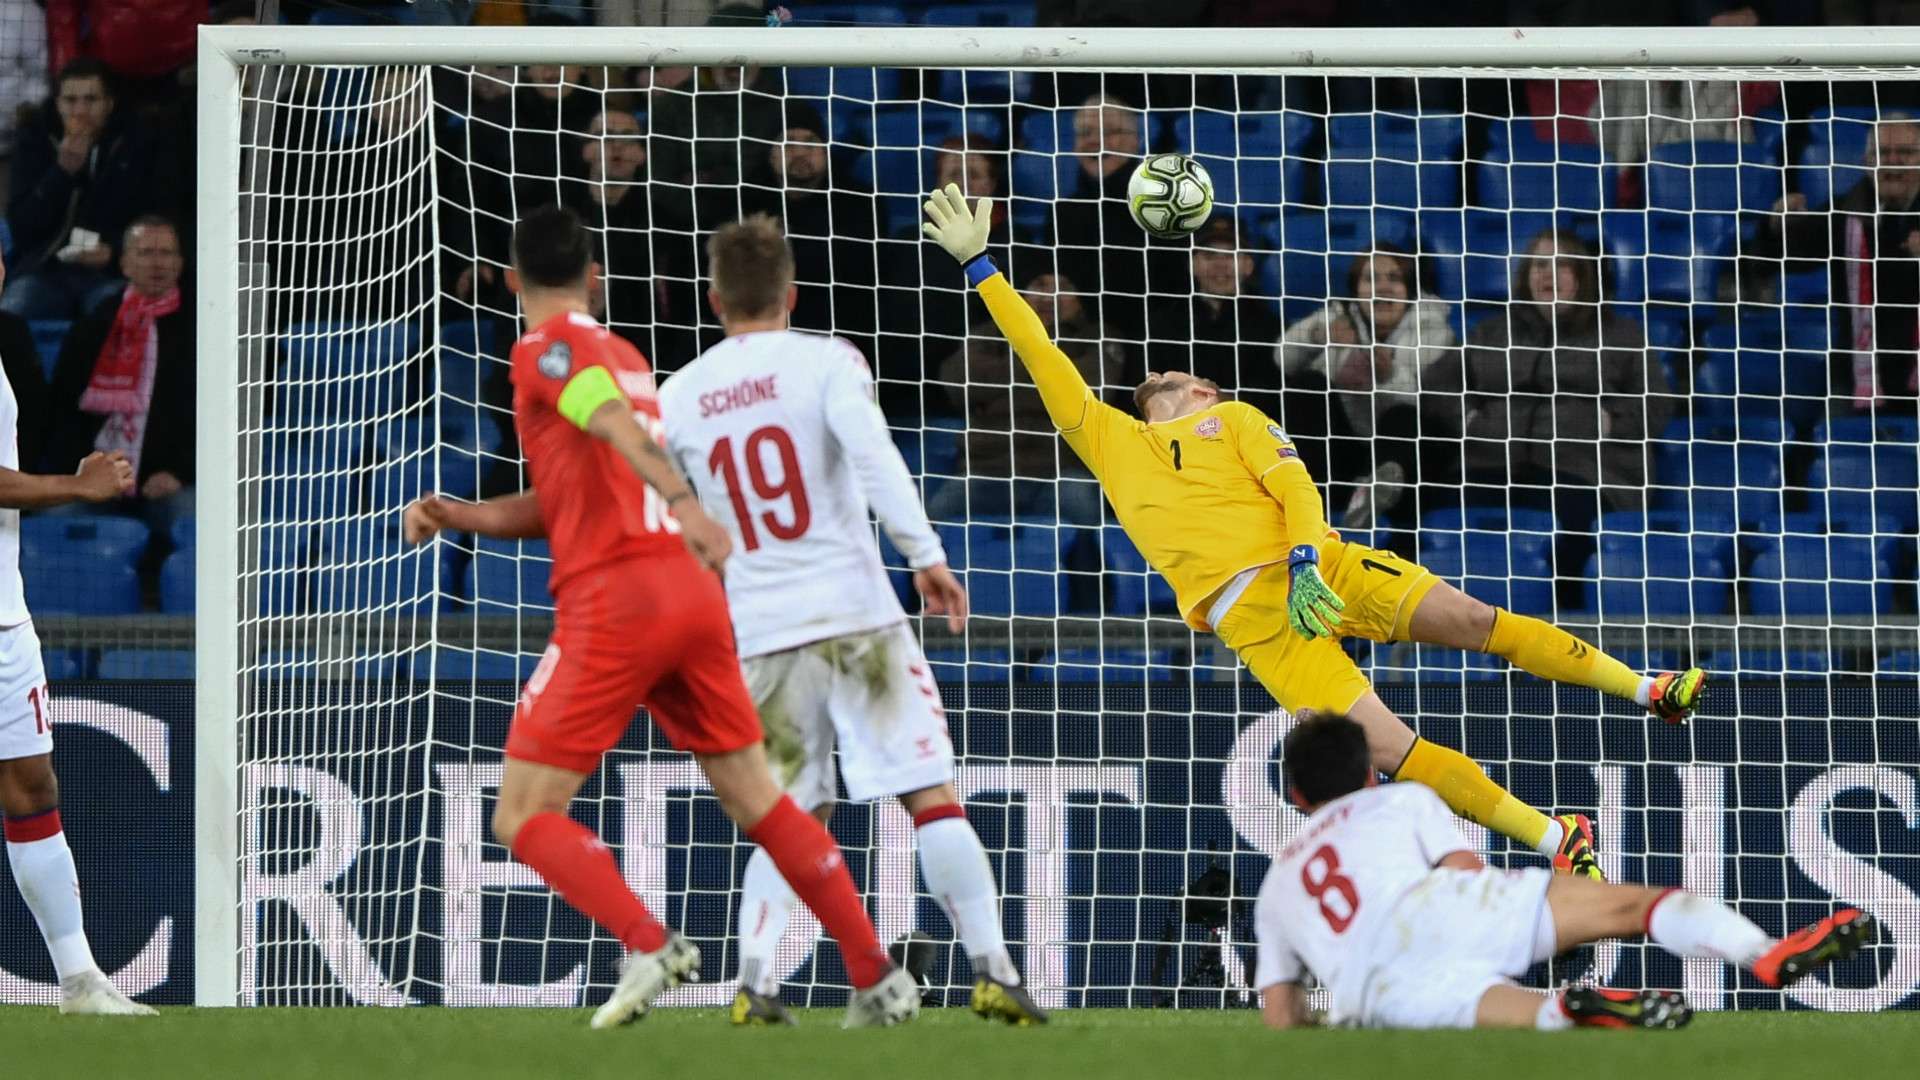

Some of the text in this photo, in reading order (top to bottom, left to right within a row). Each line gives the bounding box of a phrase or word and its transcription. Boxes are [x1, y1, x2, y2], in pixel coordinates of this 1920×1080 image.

[699, 374, 778, 418] SCHÖNE
[1169, 439, 1182, 471] 1
[708, 424, 811, 552] 19
[1361, 558, 1402, 576] 1
[1302, 844, 1359, 934] 8
